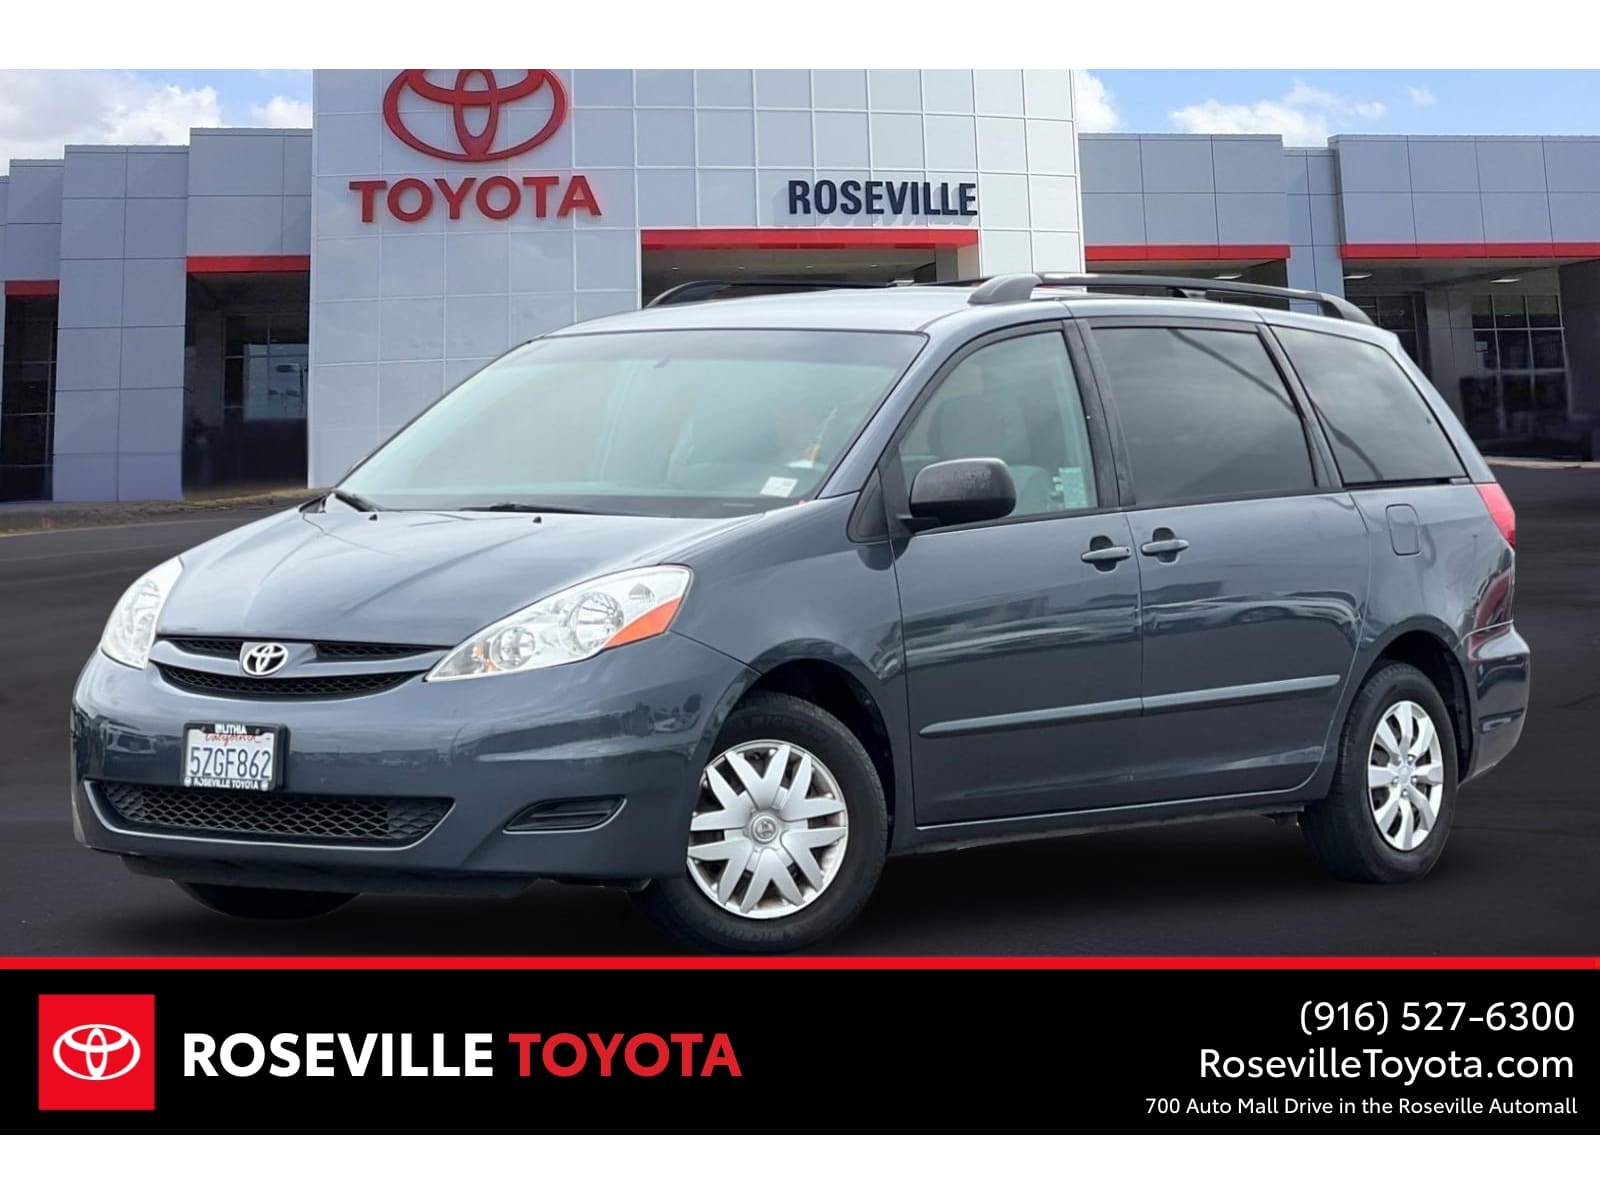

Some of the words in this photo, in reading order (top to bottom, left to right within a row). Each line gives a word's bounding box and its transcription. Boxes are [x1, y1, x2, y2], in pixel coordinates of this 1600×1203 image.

[349, 175, 602, 223] TOYOTA
[788, 179, 978, 216] ROSEVILLE
[190, 746, 271, 779] 5ZGF862
[231, 780, 259, 790] TOYOTA
